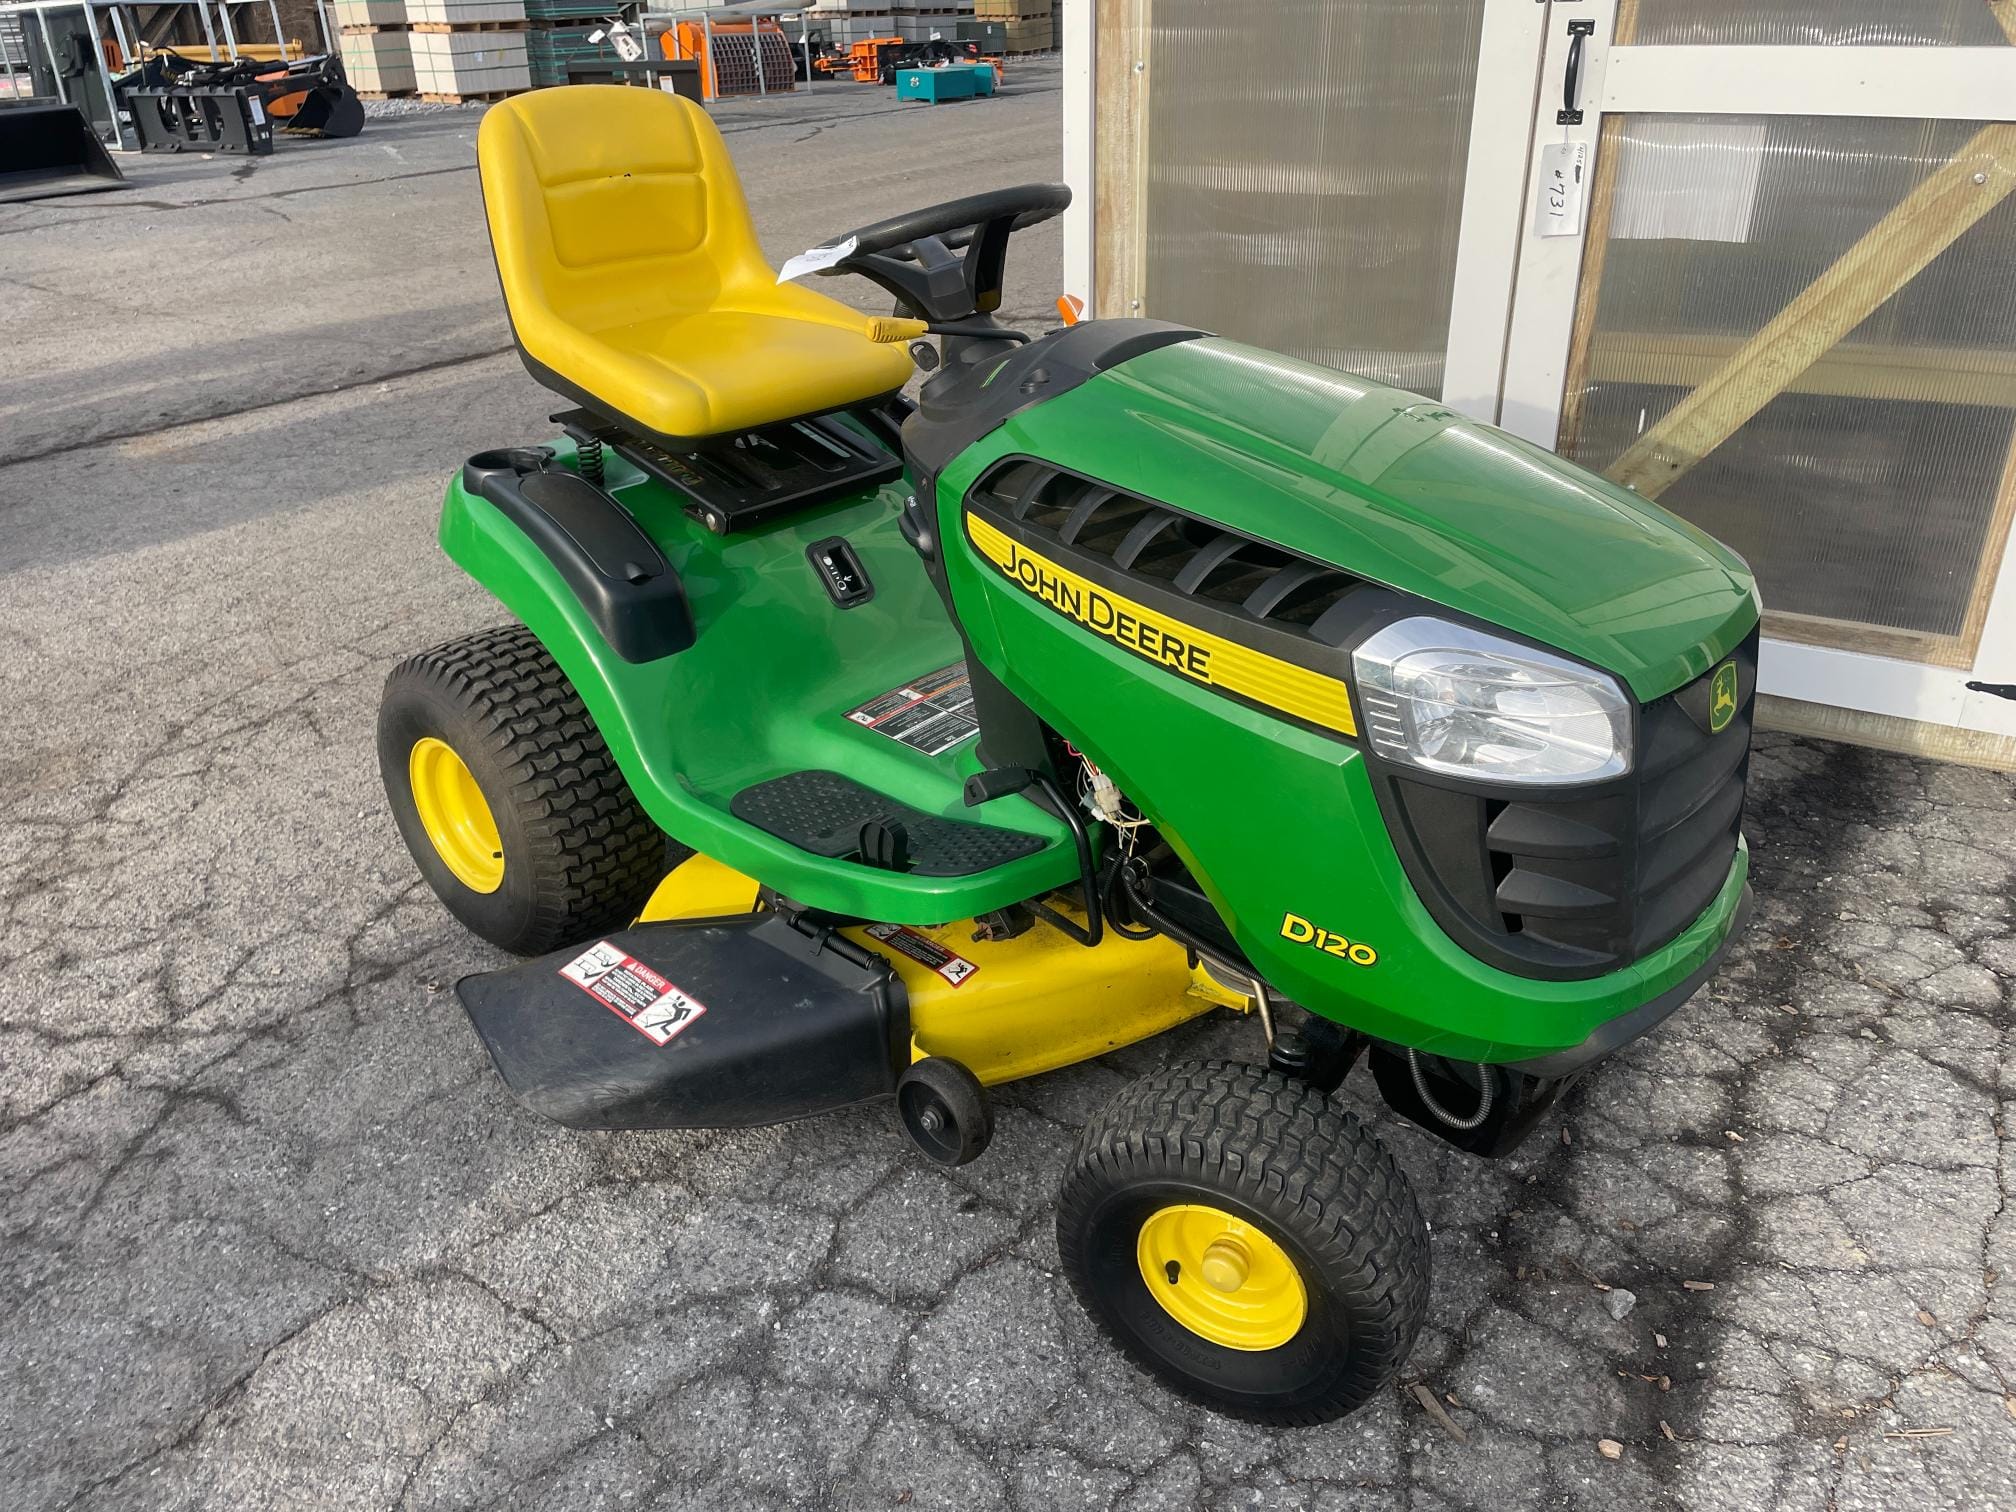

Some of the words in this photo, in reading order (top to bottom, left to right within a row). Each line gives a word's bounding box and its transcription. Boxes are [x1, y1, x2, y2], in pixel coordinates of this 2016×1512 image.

[1002, 544, 1082, 617] JOHN
[1088, 590, 1212, 680] DEERE
[1280, 911, 1378, 966] D120
[635, 966, 666, 989] DANGER
